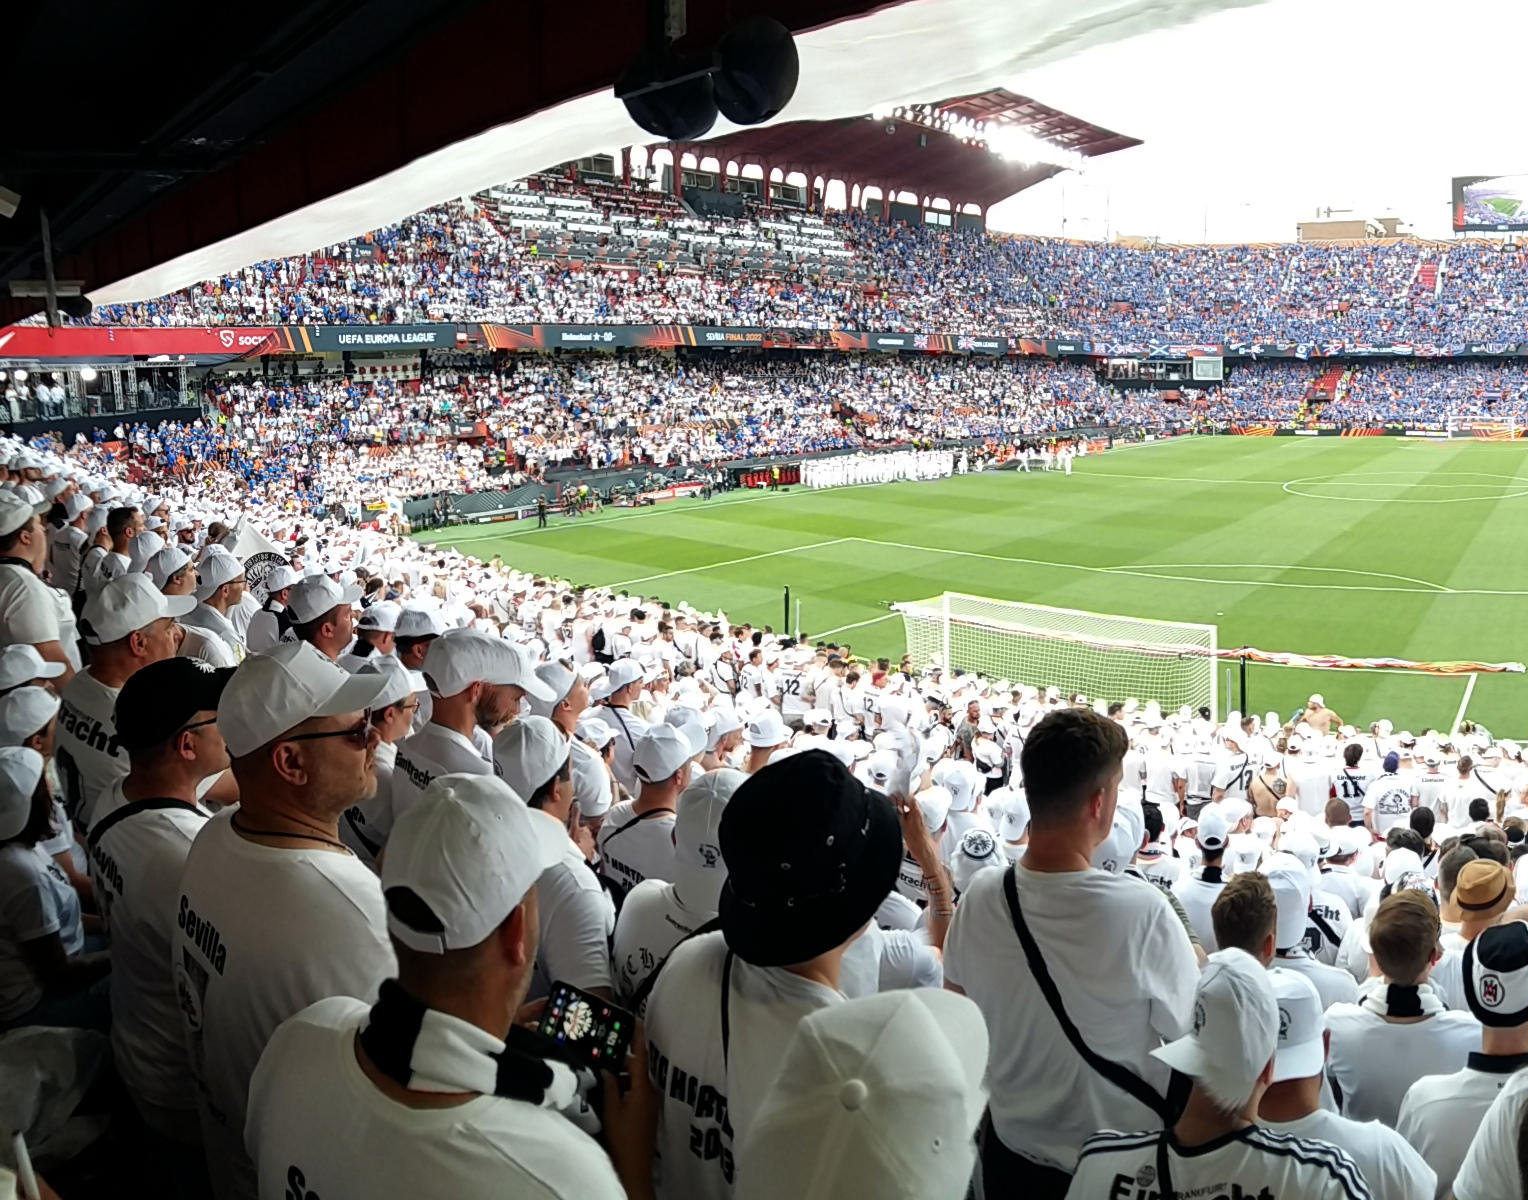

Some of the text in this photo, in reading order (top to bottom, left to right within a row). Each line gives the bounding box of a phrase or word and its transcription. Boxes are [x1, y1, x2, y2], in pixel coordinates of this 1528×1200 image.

[339, 332, 434, 345] UEFA EUROPA LEAGUE
[706, 332, 762, 342] SEVILLA FINAL 2022
[785, 678, 800, 696] 12
[863, 696, 874, 713] 12
[178, 894, 227, 976] Sevilla
